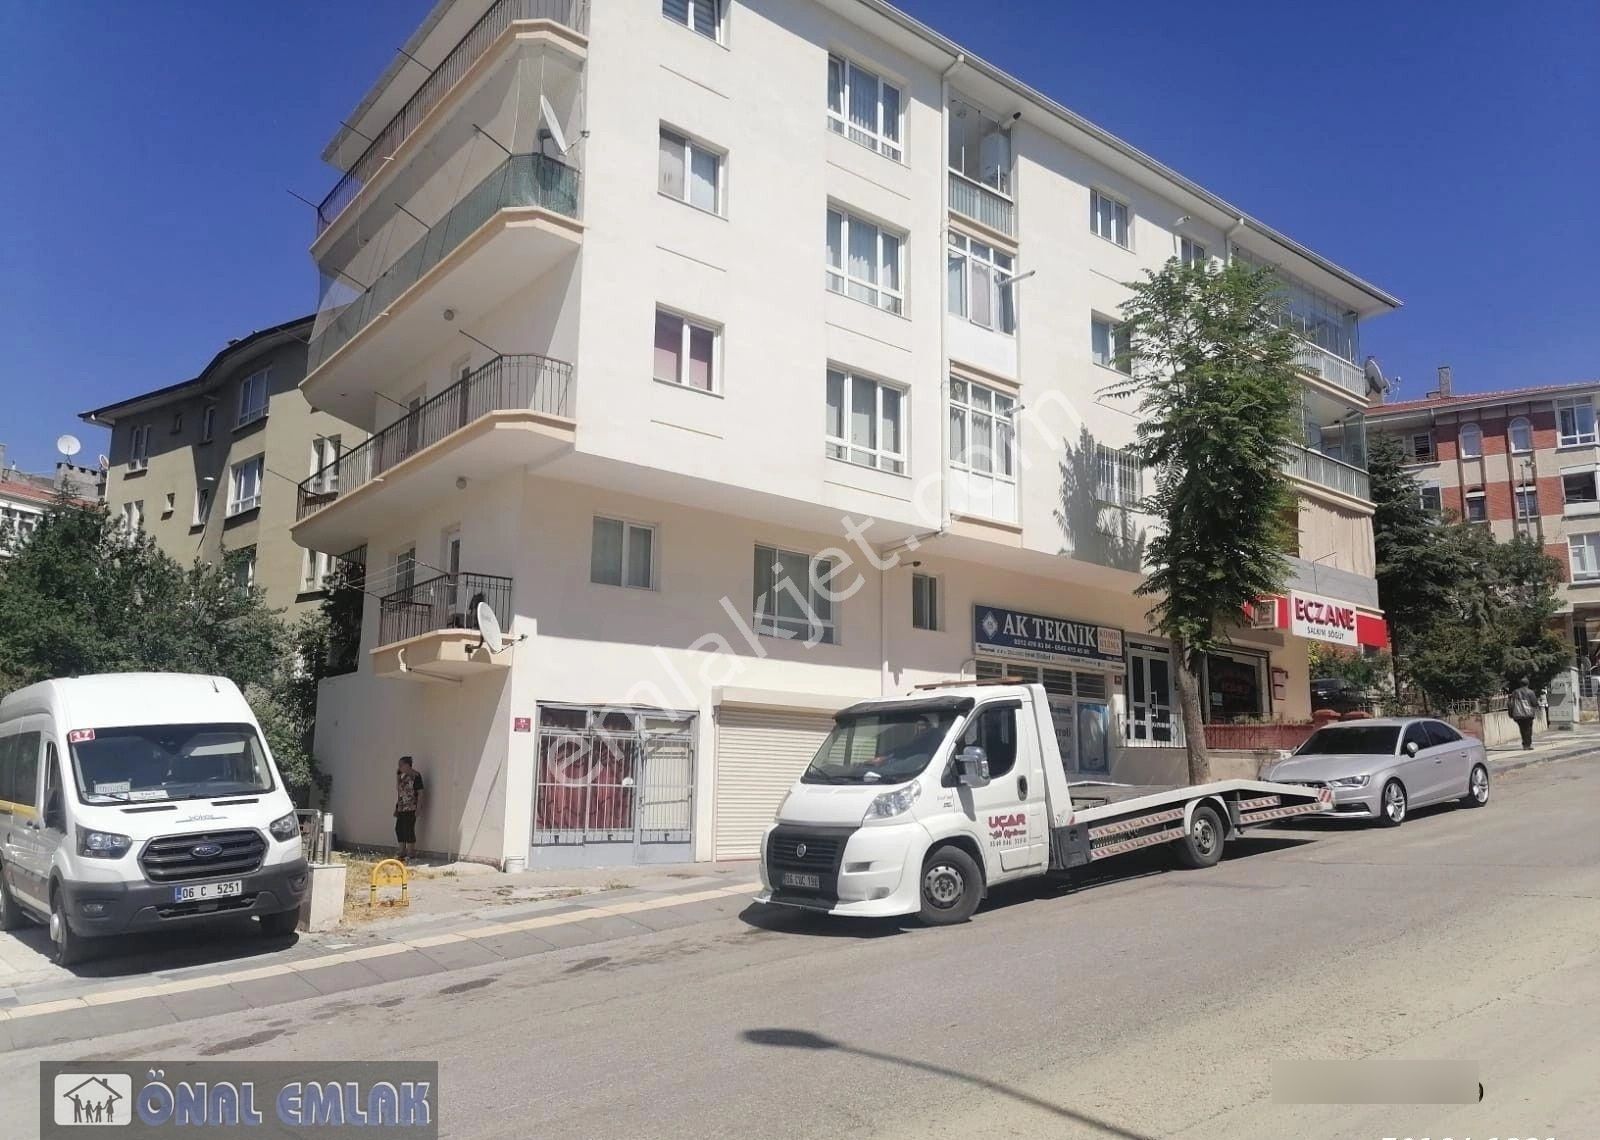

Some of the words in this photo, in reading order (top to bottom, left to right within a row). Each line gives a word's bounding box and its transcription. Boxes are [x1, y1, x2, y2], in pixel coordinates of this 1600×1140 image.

[1295, 597, 1354, 631] ECZANE
[1003, 613, 1028, 638] AK
[1032, 617, 1097, 648] TEKNİK
[988, 813, 1026, 831] UÇAR
[183, 887, 194, 899] 06
[200, 886, 207, 897] C
[217, 882, 240, 895] 5251
